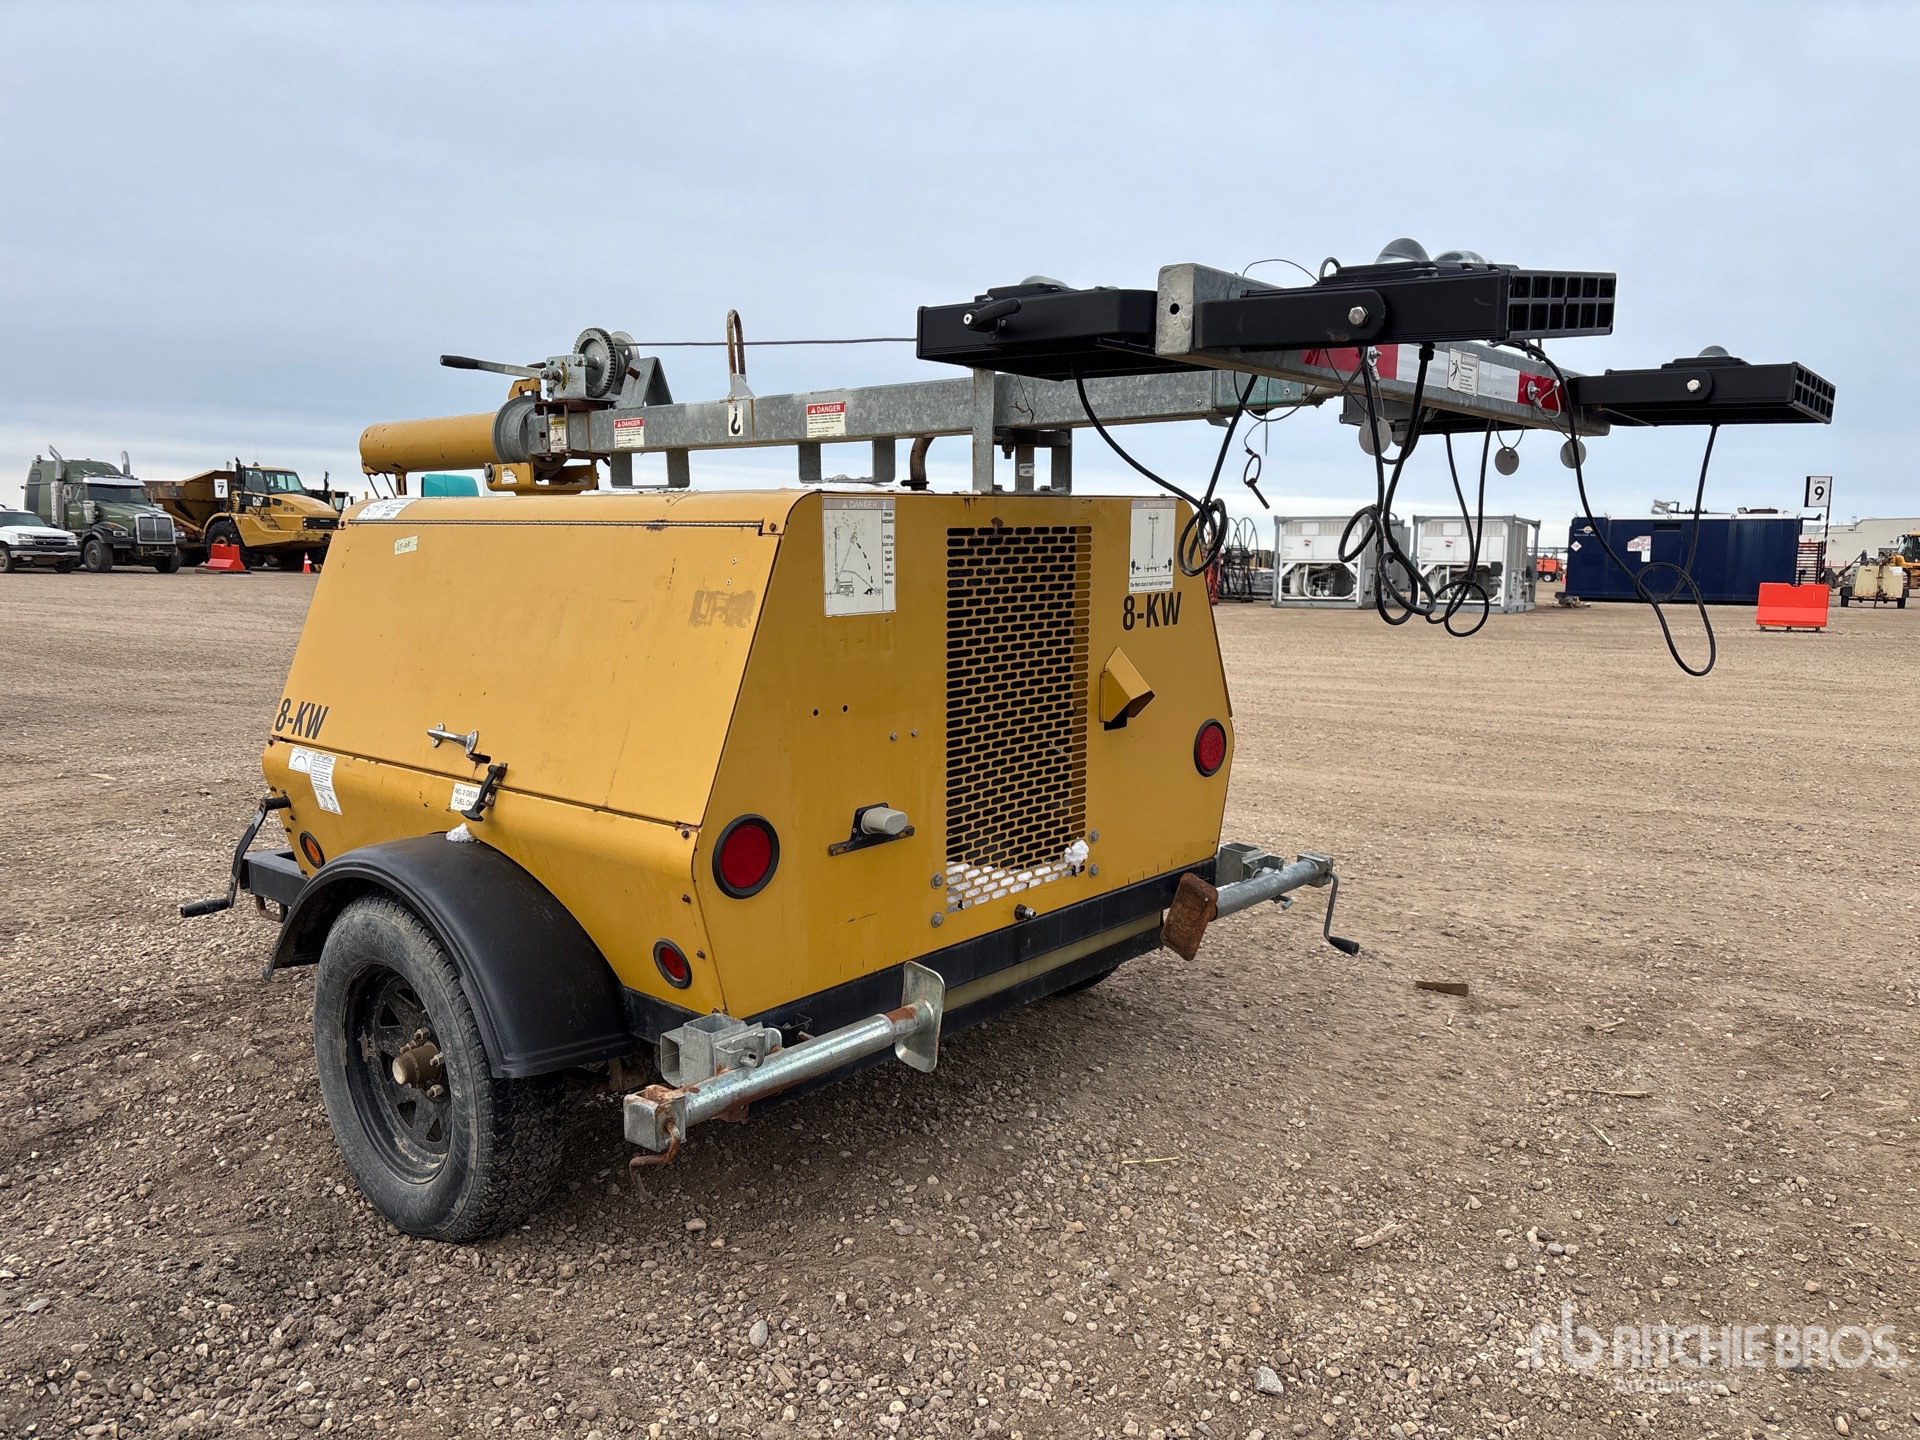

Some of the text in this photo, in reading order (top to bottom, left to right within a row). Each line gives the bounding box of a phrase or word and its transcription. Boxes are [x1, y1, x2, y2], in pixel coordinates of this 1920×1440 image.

[816, 404, 841, 413] DANGER
[621, 419, 641, 427] DANGER
[217, 484, 225, 494] 7
[1814, 485, 1825, 501] 9
[849, 500, 878, 509] DANGER
[1147, 500, 1166, 508] DANGER
[1122, 591, 1182, 631] 8-KW
[275, 697, 330, 740] 8-KW
[465, 789, 480, 799] DIESE
[454, 796, 475, 807] FUEL ON
